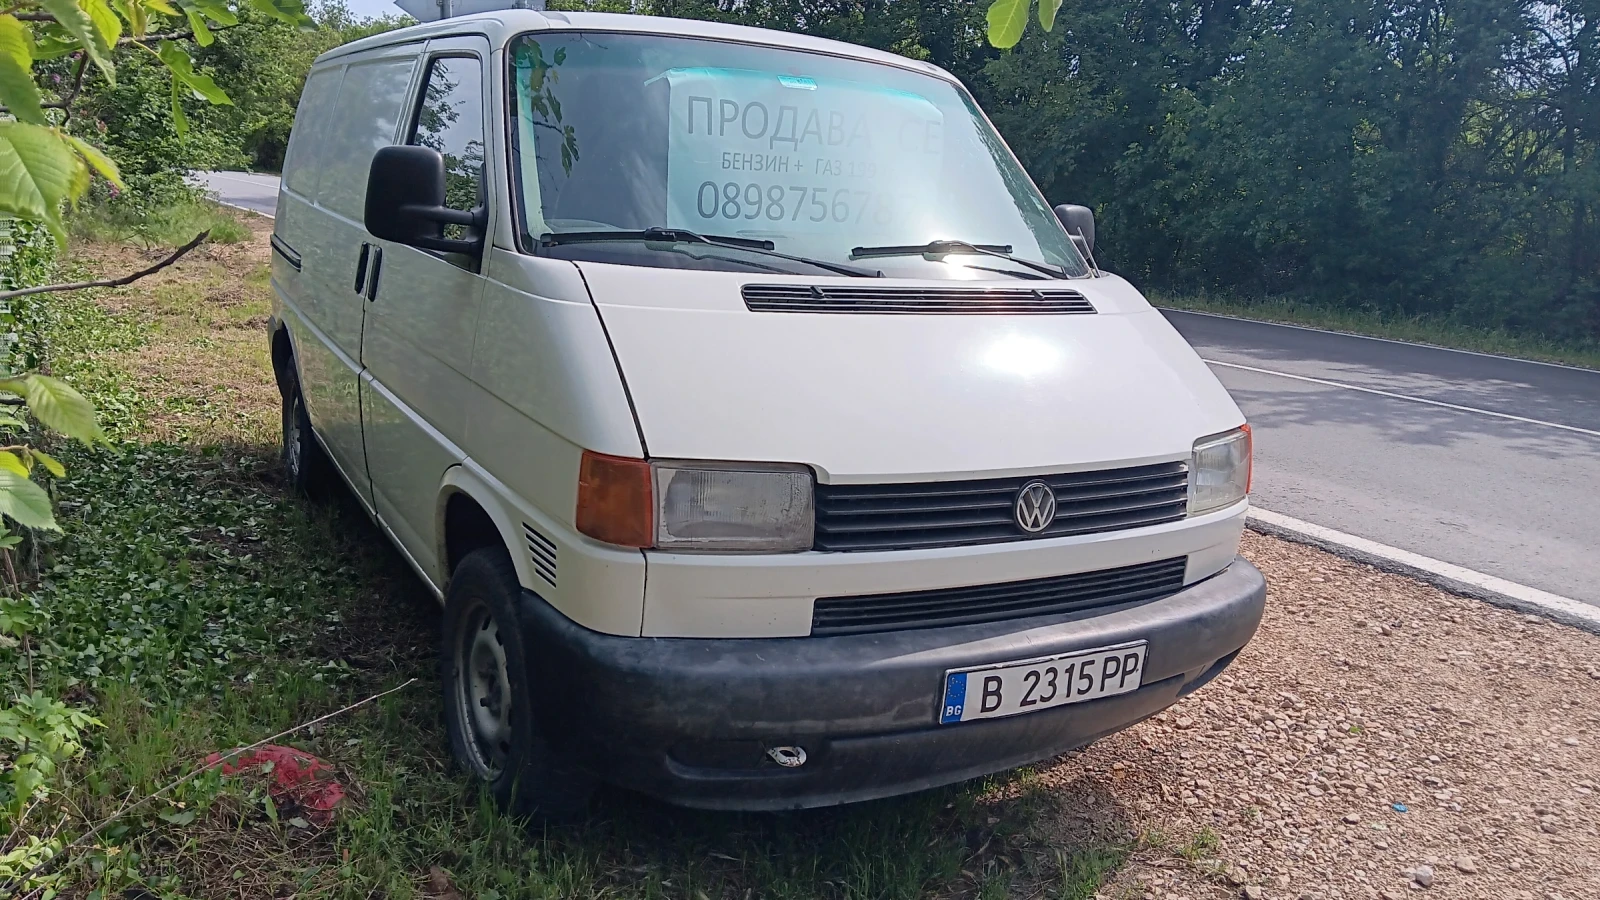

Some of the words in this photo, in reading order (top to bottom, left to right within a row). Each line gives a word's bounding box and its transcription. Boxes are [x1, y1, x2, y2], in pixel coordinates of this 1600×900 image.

[687, 95, 872, 152] ПРОДАВА
[898, 118, 941, 155] СЕ
[814, 157, 843, 177] ГАЗ
[1017, 483, 1055, 532] VW
[945, 705, 962, 717] BG
